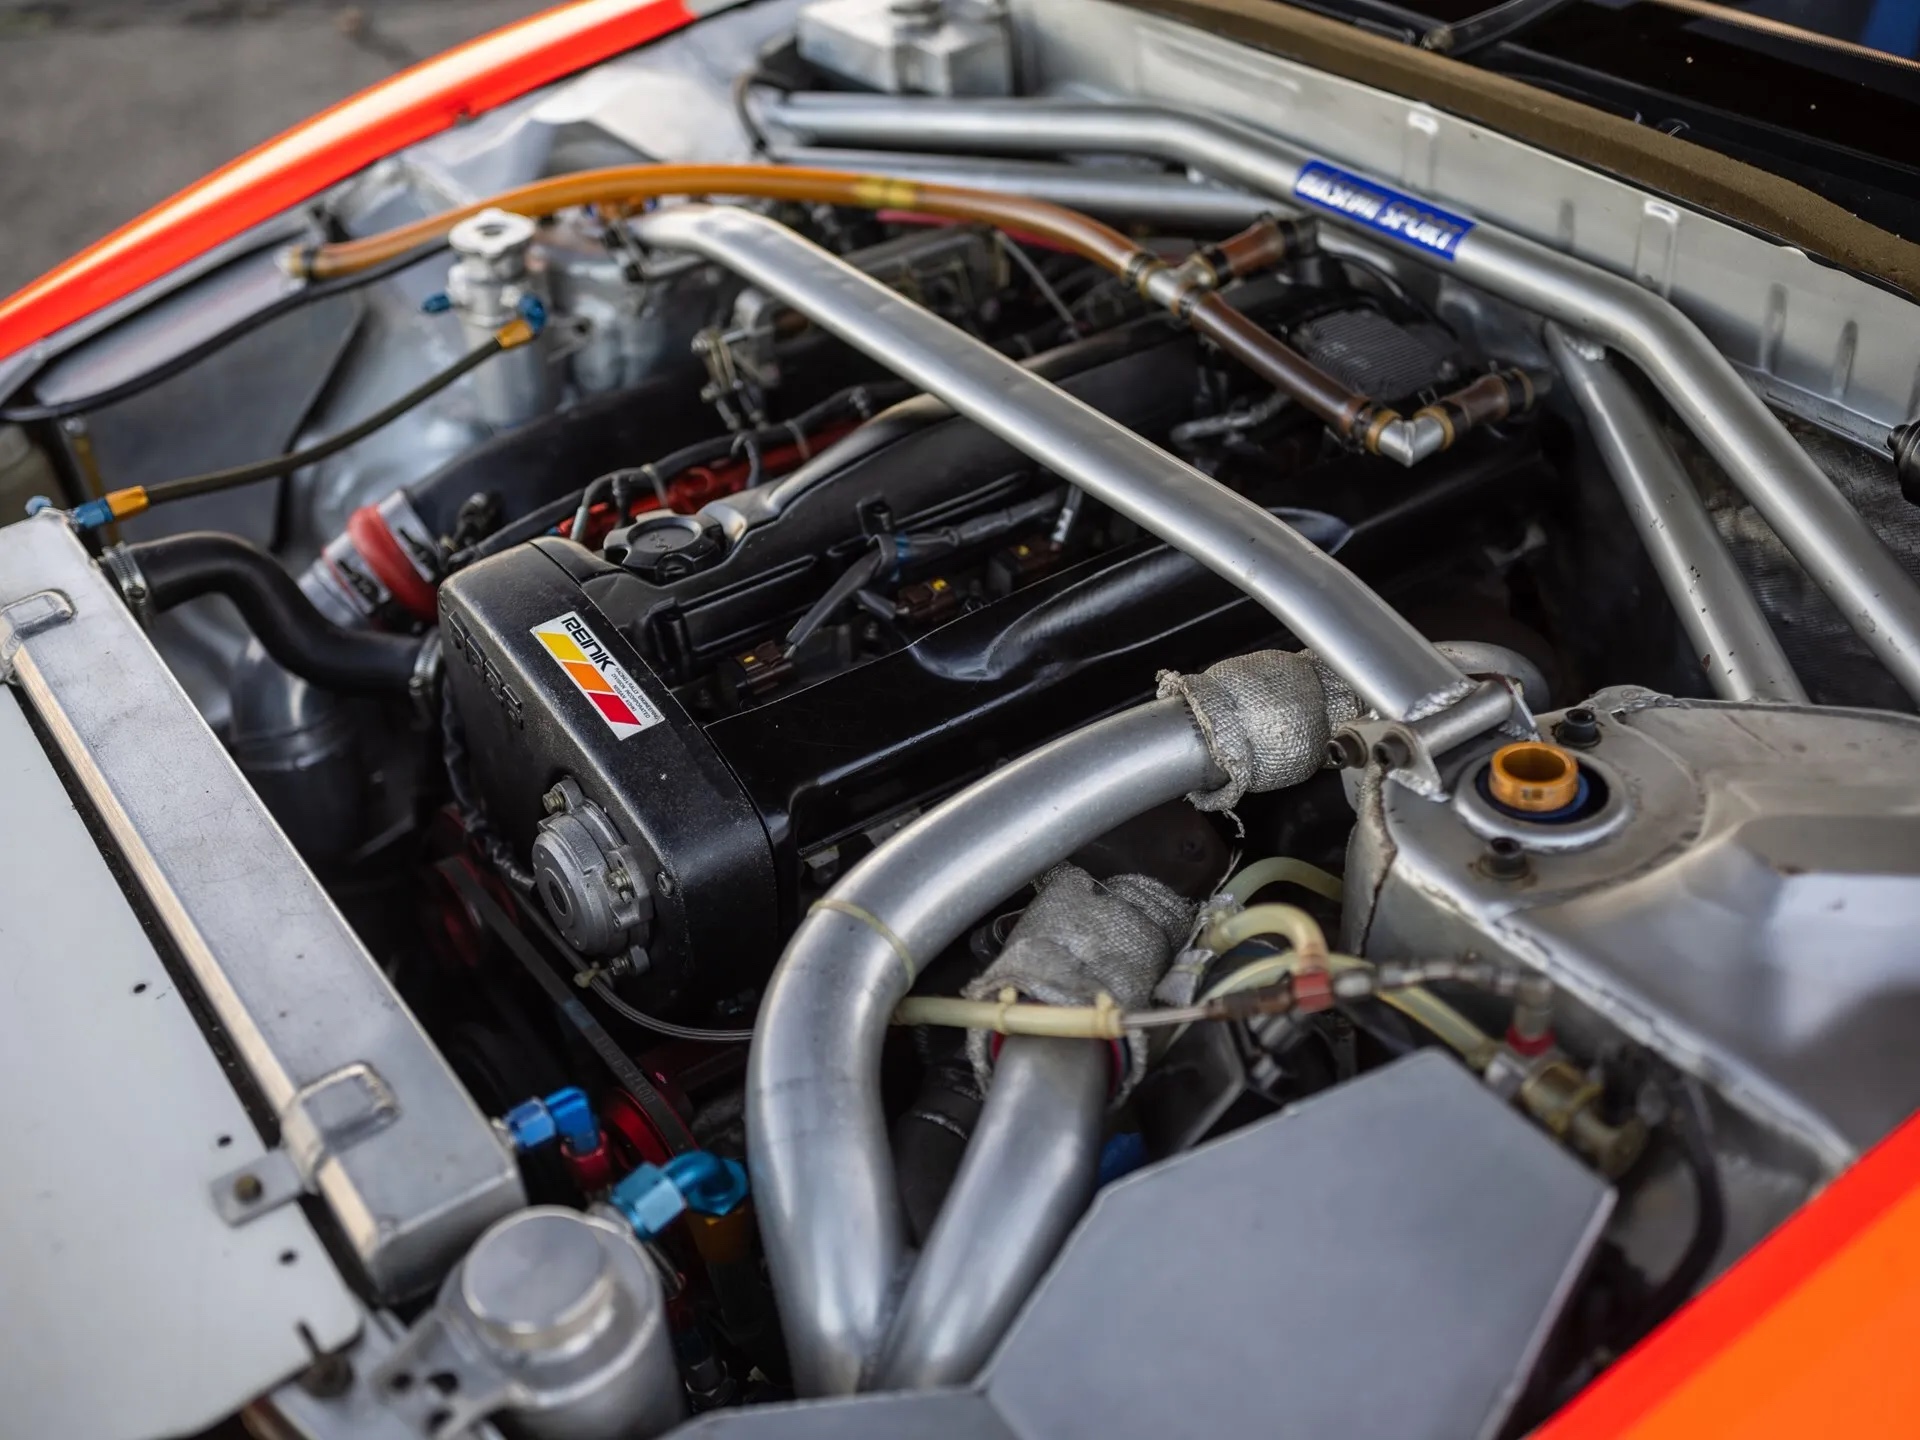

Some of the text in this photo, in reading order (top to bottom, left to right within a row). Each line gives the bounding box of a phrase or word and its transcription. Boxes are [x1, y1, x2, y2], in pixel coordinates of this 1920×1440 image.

[561, 616, 617, 672] REINIK
[614, 666, 627, 681] RACING
[626, 682, 639, 695] RALLY
